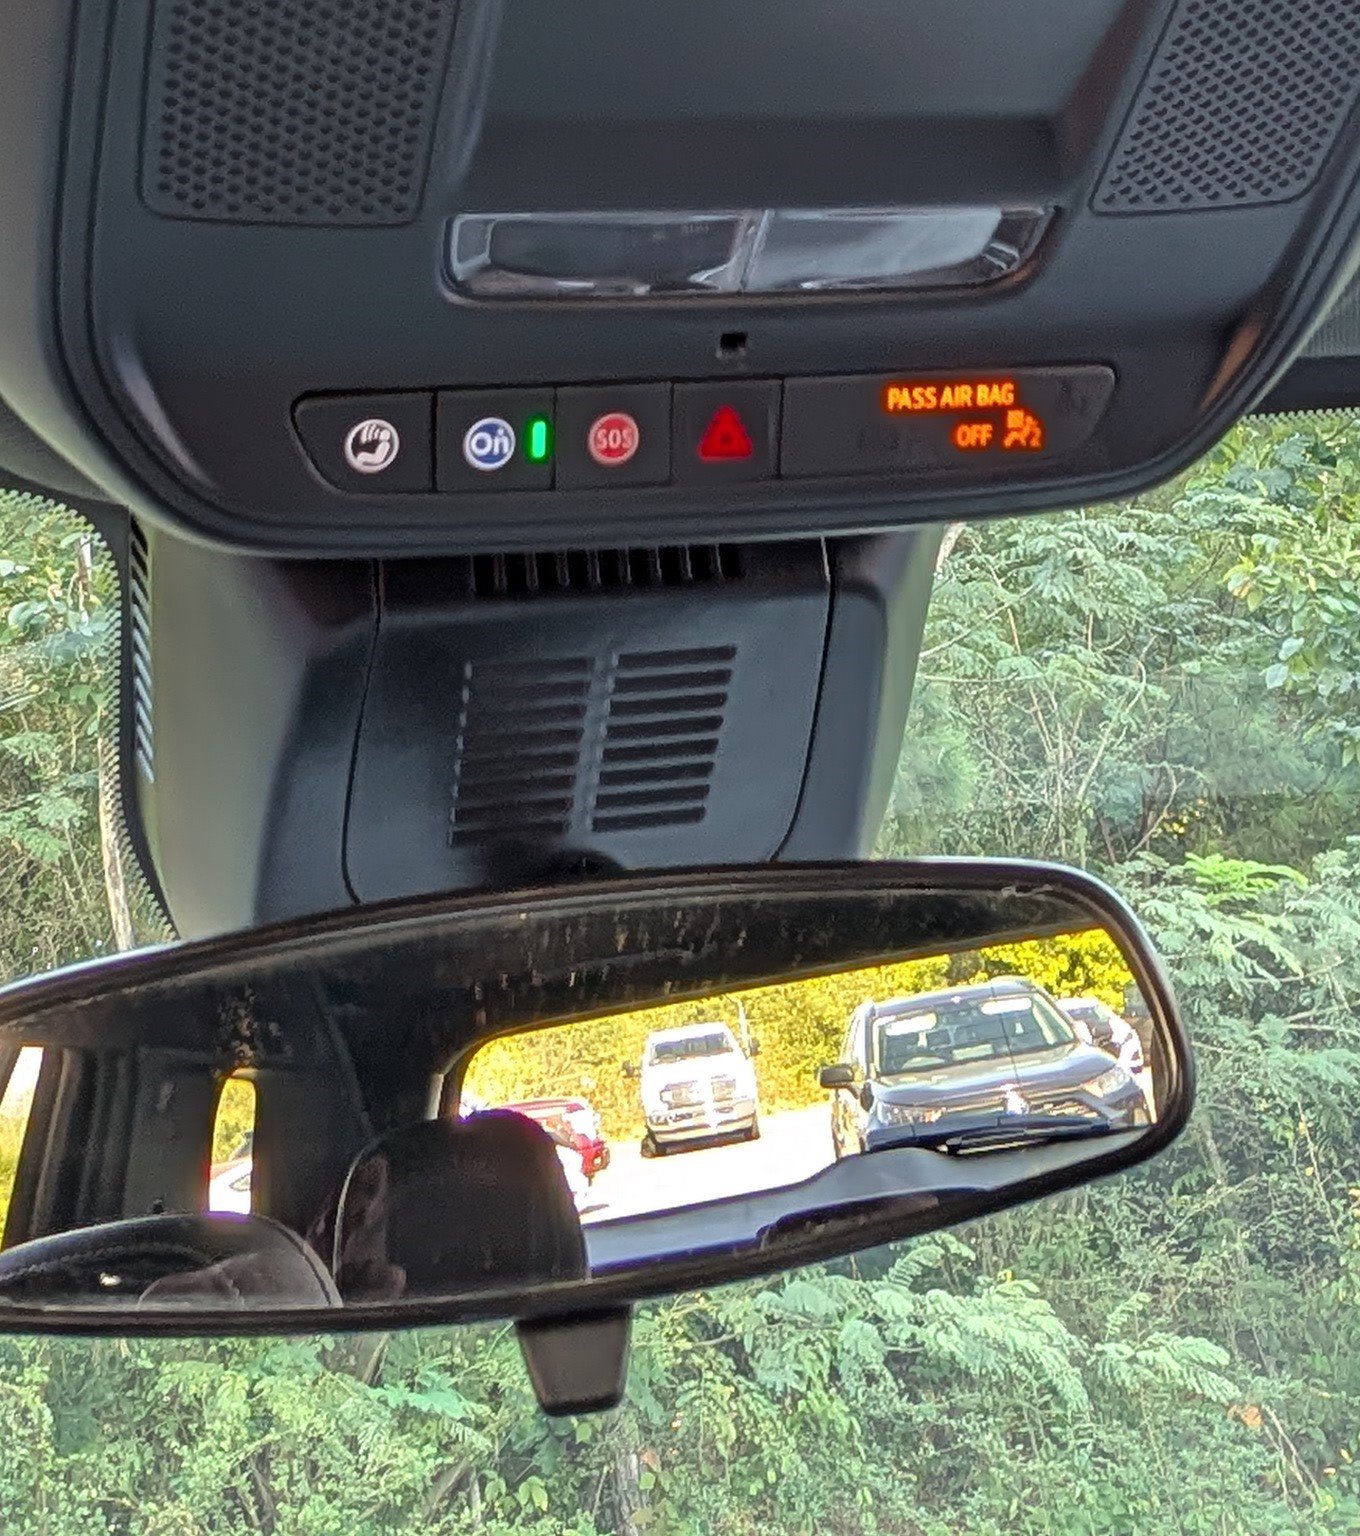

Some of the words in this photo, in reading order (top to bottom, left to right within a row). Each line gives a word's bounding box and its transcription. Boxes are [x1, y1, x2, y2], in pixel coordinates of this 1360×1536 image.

[887, 386, 937, 410] PASS
[940, 384, 973, 409] AIR
[976, 382, 1015, 406] BAG
[596, 428, 634, 451] SOS
[956, 423, 993, 447] OFF
